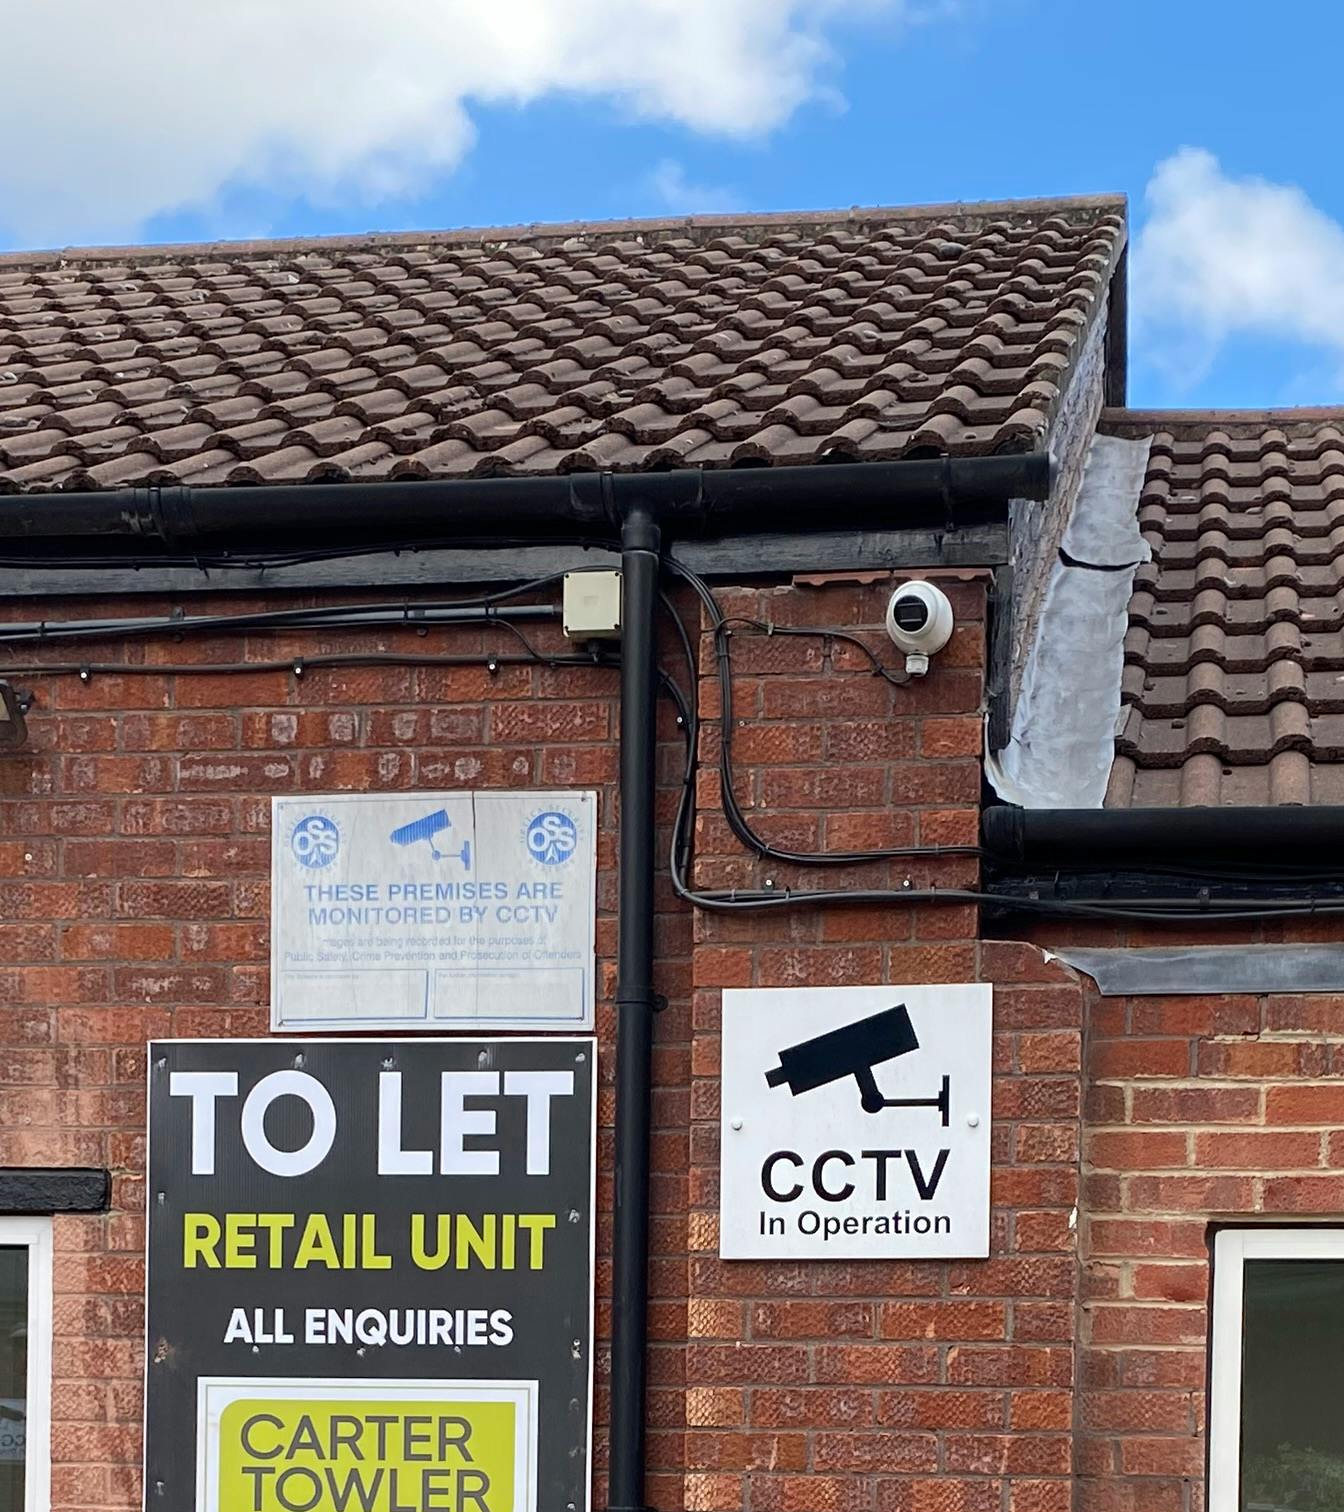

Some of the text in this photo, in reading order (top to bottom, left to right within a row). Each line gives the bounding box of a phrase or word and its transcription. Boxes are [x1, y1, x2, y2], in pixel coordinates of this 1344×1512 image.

[303, 881, 563, 901] THESE PREMISES ARE
[308, 904, 559, 926] MONITORED BY CCTV
[284, 952, 313, 962] Public
[352, 951, 381, 962] Crime
[384, 951, 435, 962] Prevention
[439, 950, 458, 961] and
[460, 949, 519, 961] Prosecution
[406, 935, 451, 947] recorded
[469, 935, 487, 946] the
[488, 936, 535, 949] purposes
[169, 1070, 574, 1177] TO LET
[761, 1148, 951, 1202] CCTV
[183, 1213, 556, 1270] RETAIL UNIT
[760, 1209, 951, 1241] In Operation
[223, 1308, 514, 1346] ALL ENQUIRIES
[240, 1413, 474, 1462] CARTER
